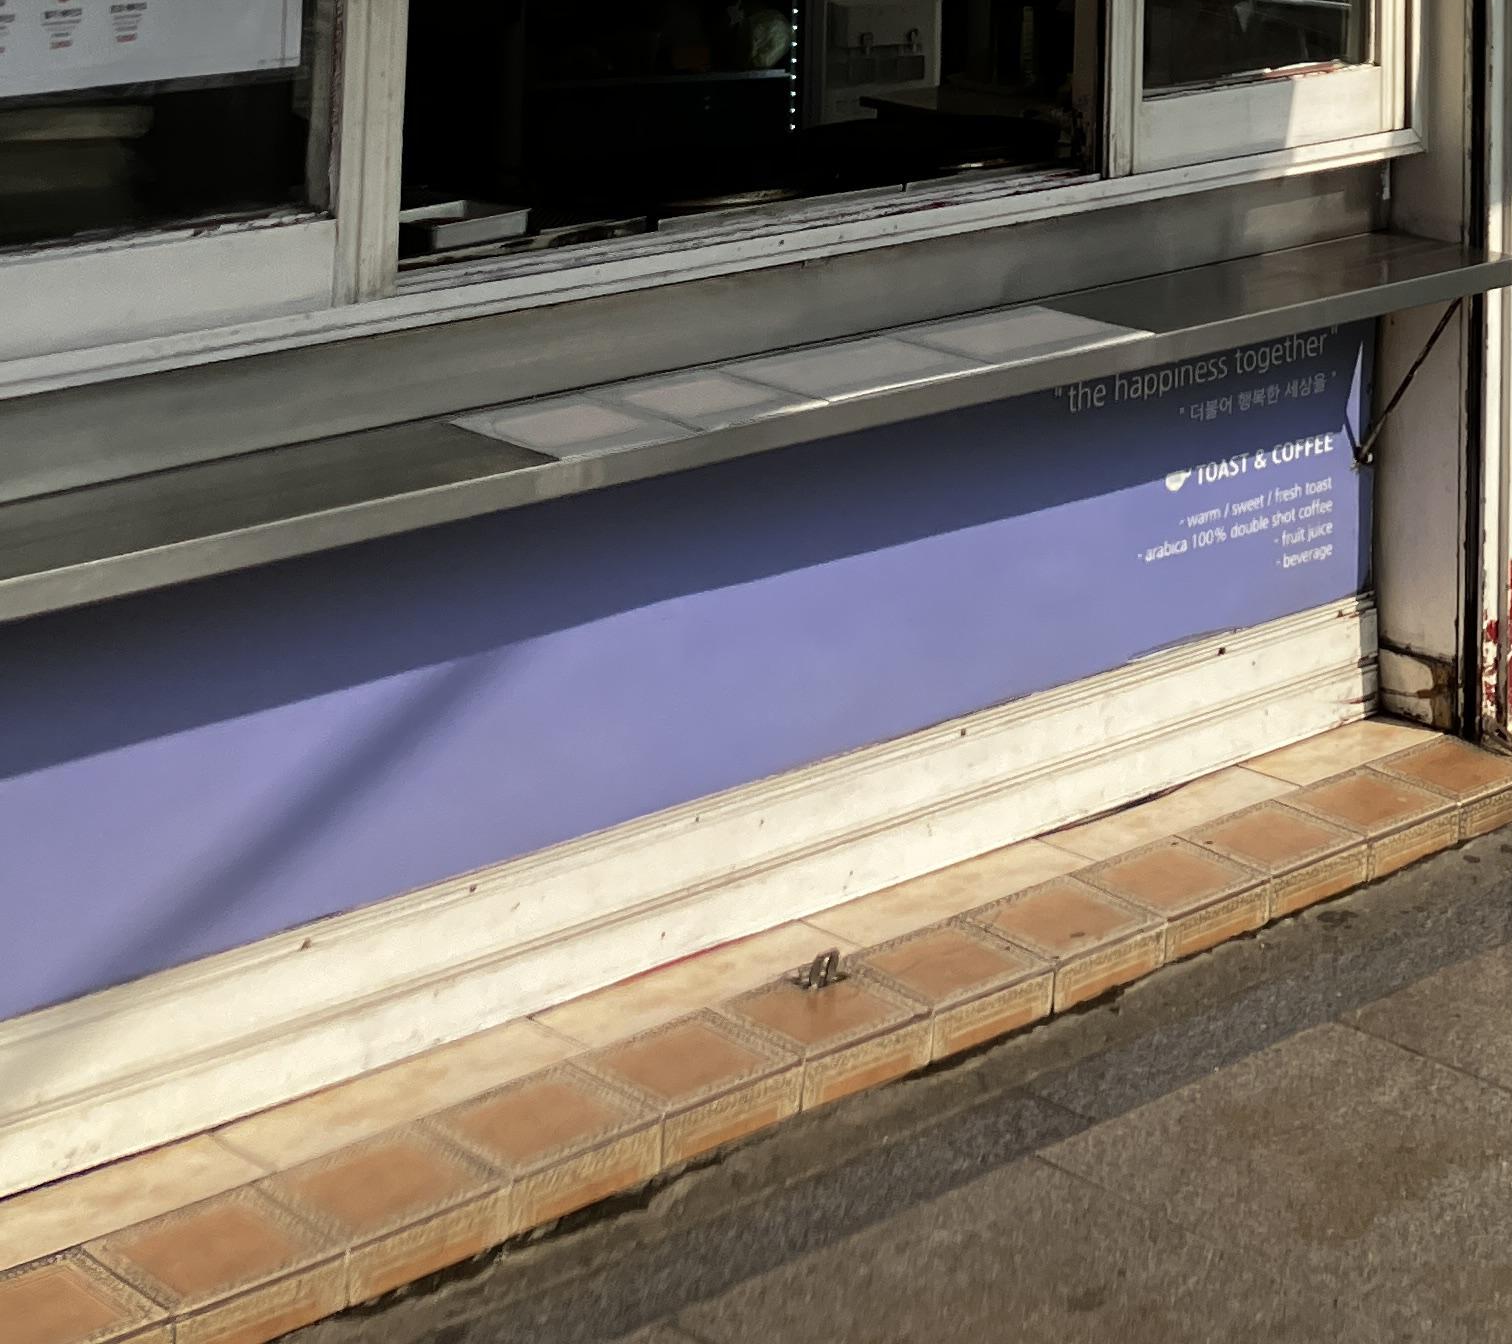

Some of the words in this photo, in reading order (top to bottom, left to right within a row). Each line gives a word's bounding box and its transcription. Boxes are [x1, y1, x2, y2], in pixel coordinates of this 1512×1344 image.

[1068, 382, 1105, 413] the
[1114, 354, 1228, 401] happiness
[1233, 333, 1327, 374] together
[1190, 397, 1233, 422] 더불어
[1237, 384, 1280, 412] 행복한
[1283, 372, 1326, 399] 세상을
[1196, 452, 1250, 485] TOAST
[1254, 448, 1267, 469] &
[1271, 432, 1335, 464] COFFEE
[1232, 494, 1264, 516] sweet
[1275, 486, 1302, 503] fresh
[1305, 477, 1333, 495] toast
[1145, 538, 1188, 562] arabica
[1192, 527, 1227, 550] 100%
[1230, 516, 1269, 538] double
[1271, 509, 1295, 528] shot
[1298, 499, 1333, 519] coffee
[1281, 527, 1305, 547] fruit
[1306, 522, 1333, 542] juice
[1283, 543, 1333, 568] beverage
